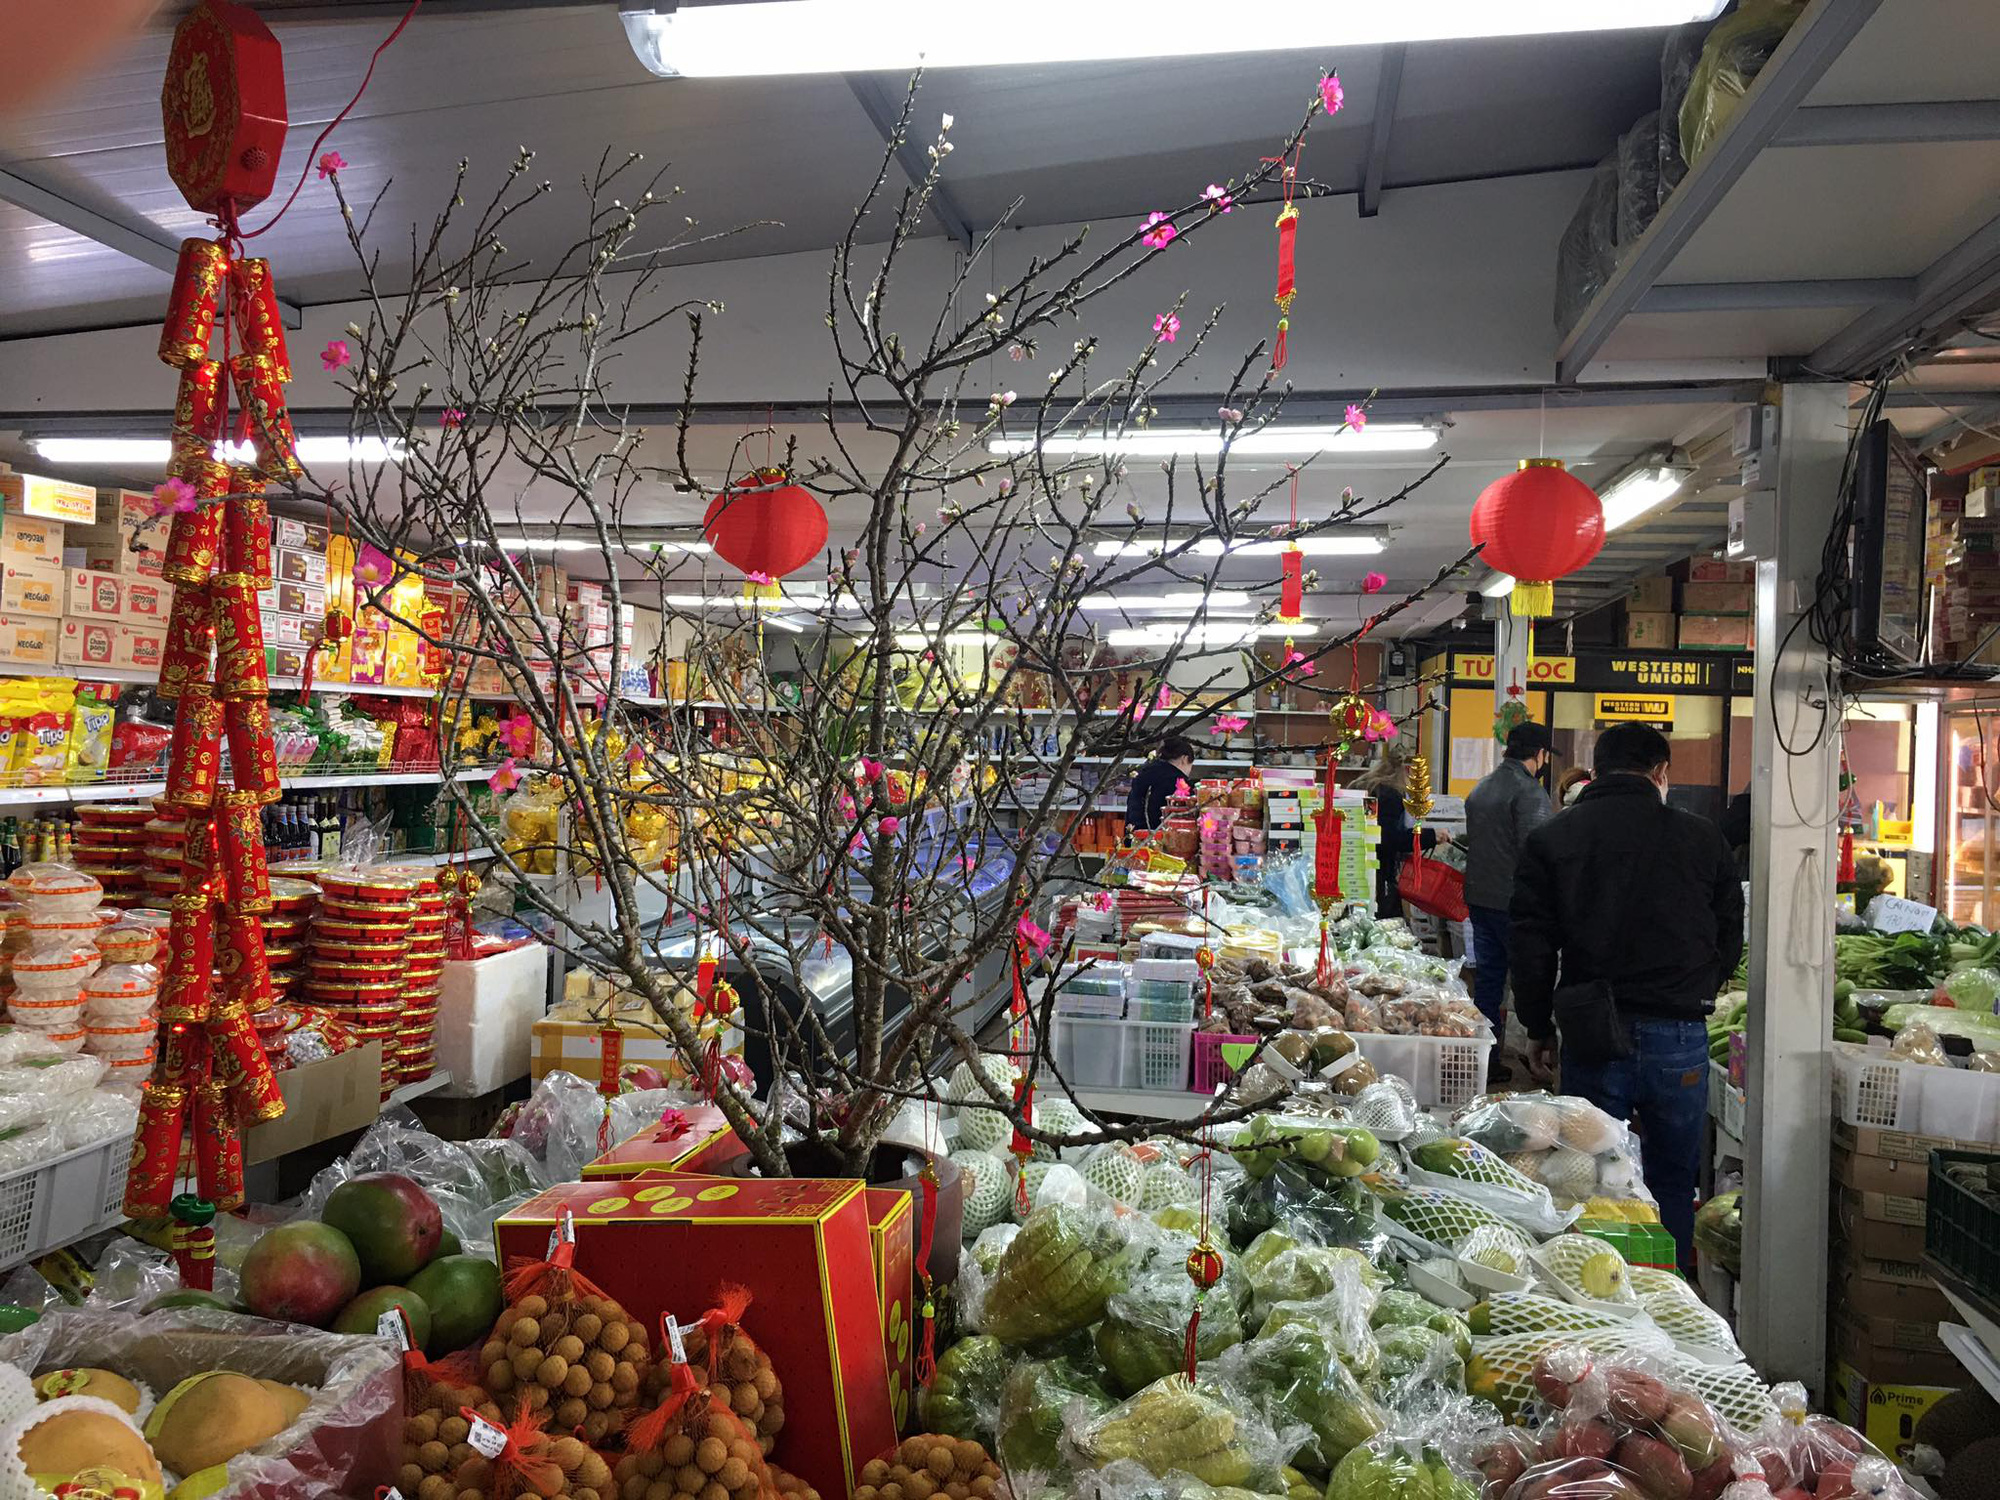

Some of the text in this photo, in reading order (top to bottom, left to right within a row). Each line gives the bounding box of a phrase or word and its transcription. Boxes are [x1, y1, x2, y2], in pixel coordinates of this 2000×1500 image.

[24, 591, 51, 602] NEOGURI
[17, 639, 44, 650] NEOGURI
[1611, 661, 1696, 673] WESTERN
[1637, 673, 1696, 685] UNION
[1643, 702, 1666, 713] WU
[84, 713, 110, 733] Tipo
[37, 728, 65, 746] Tipo
[1887, 1391, 1924, 1406] Prime
